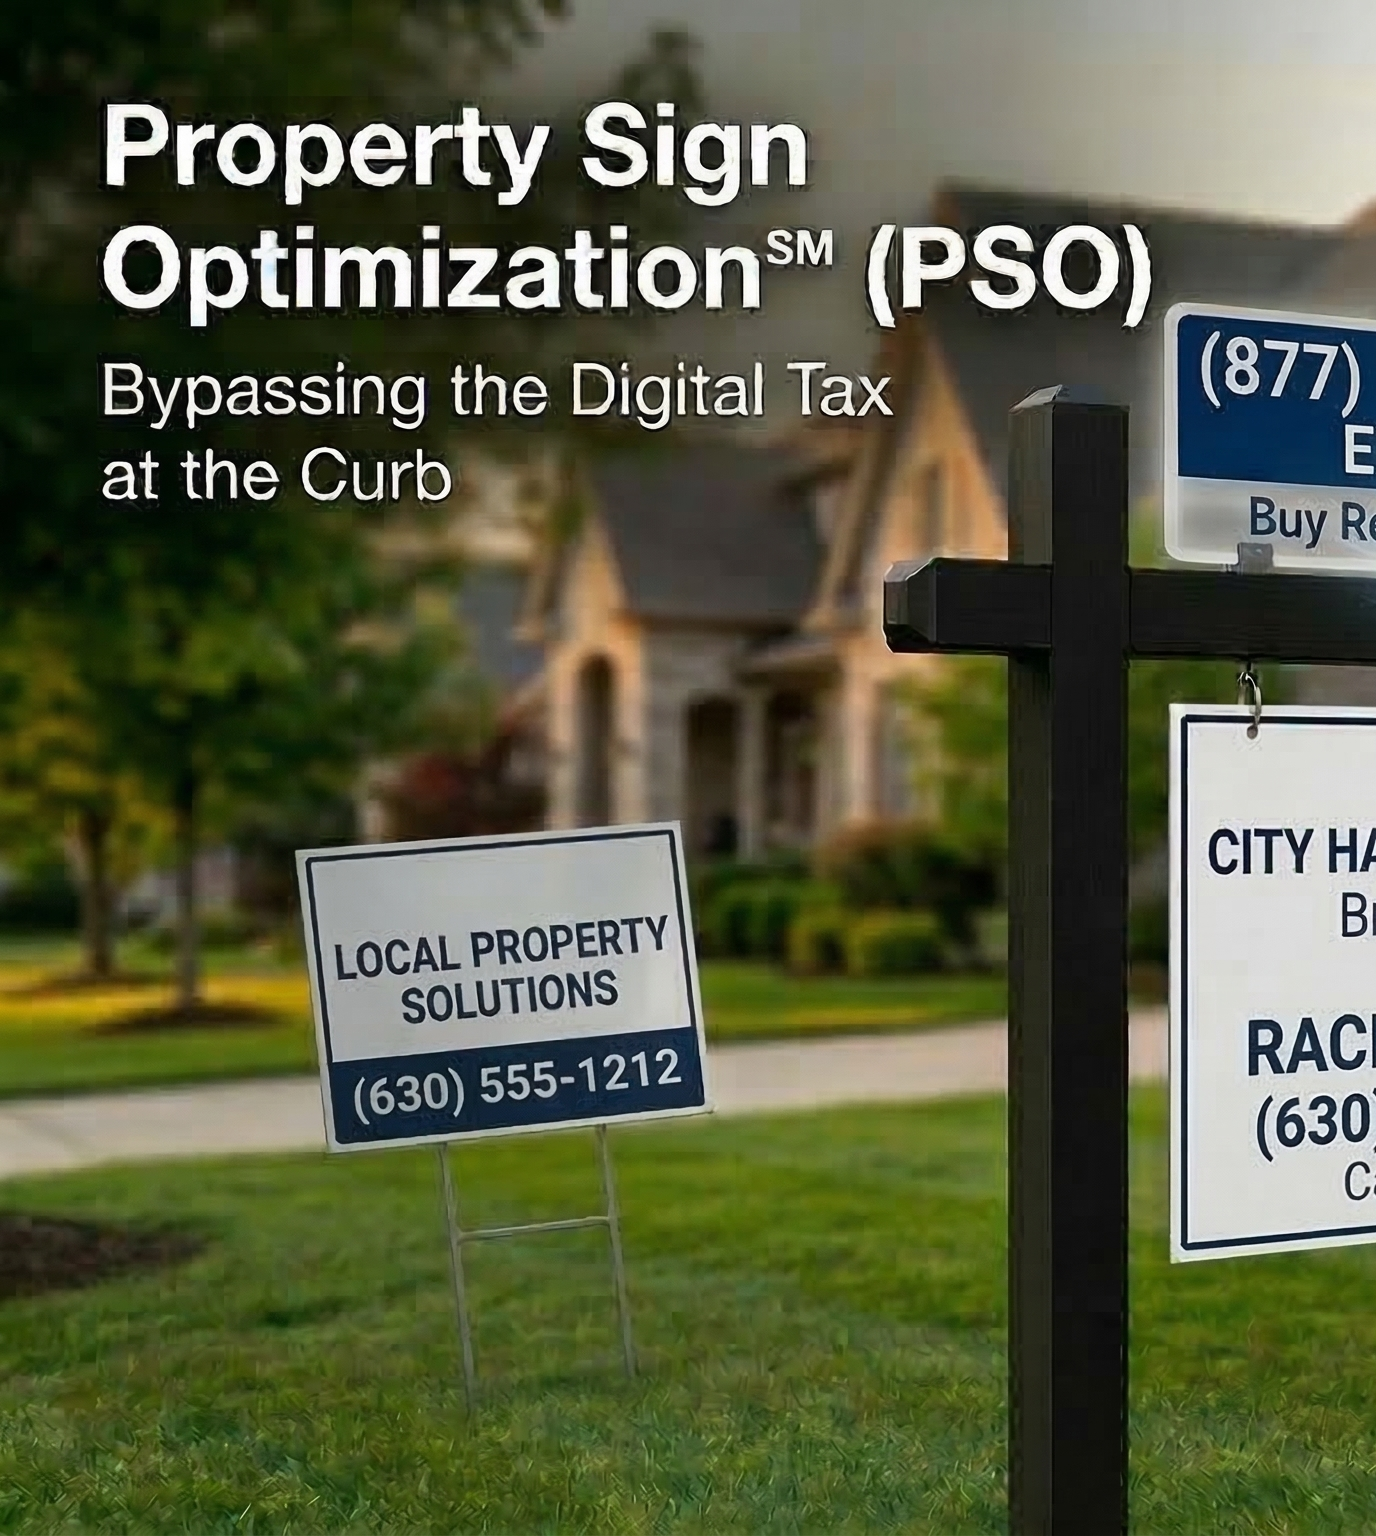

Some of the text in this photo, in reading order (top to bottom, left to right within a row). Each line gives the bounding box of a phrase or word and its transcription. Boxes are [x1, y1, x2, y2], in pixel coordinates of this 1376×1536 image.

[1200, 331, 1360, 417] (877)
[1249, 496, 1327, 549] Buy
[1208, 827, 1315, 876] CITY
[334, 914, 668, 981] LOCAL PROPERTY
[401, 969, 619, 1024] SOLUTIONS
[354, 1048, 682, 1125] (630) 555-1212
